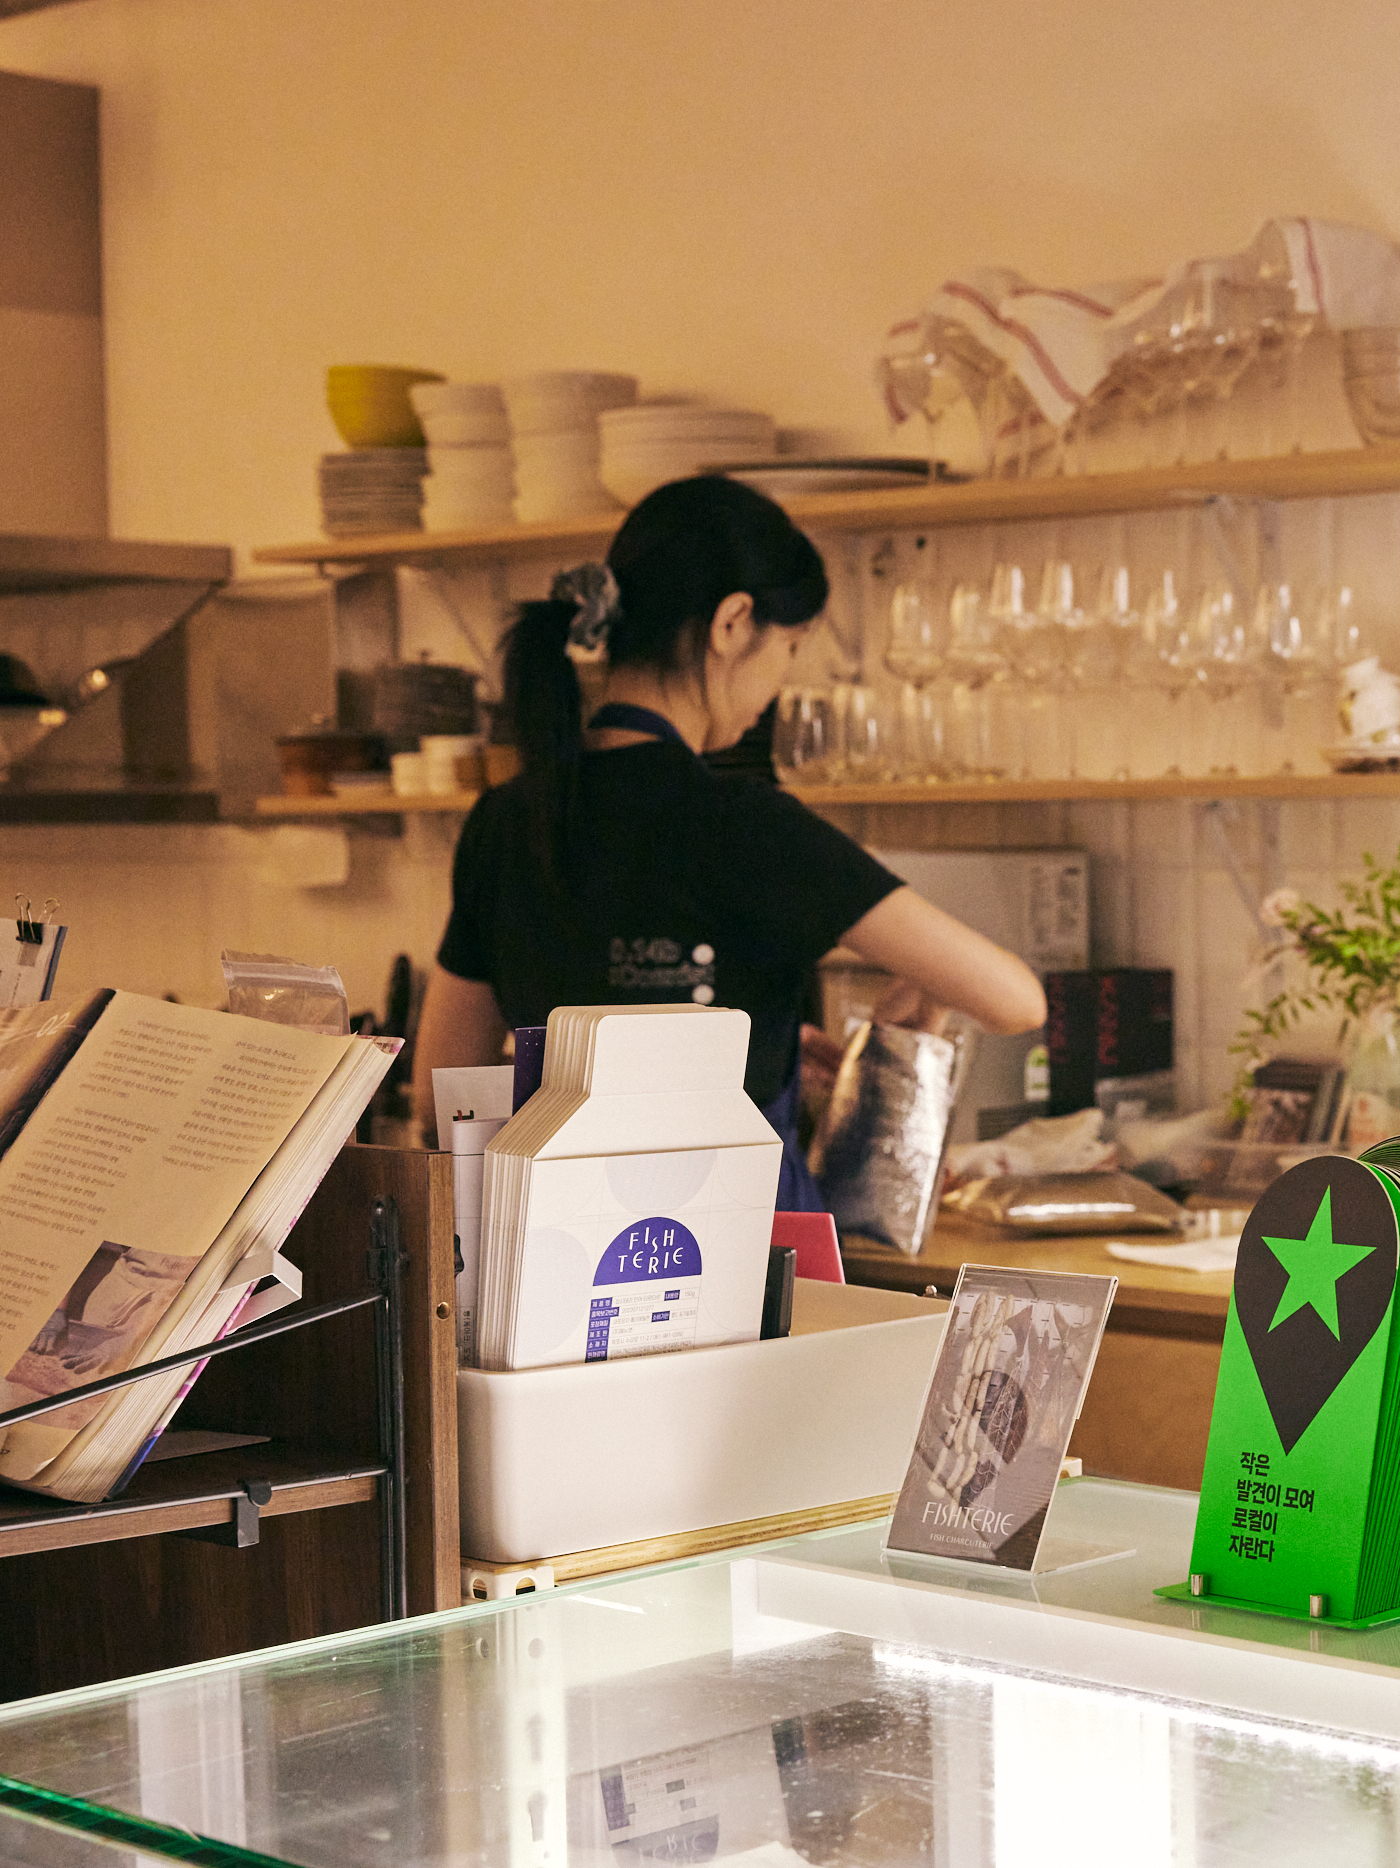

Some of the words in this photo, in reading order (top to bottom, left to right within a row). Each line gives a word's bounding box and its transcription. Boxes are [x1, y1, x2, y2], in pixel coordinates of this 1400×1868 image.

[629, 1227, 674, 1254] FISH
[618, 1246, 684, 1275] TERIE
[1240, 1451, 1271, 1477] 작은
[1236, 1479, 1282, 1507] 발견이
[1282, 1487, 1316, 1513] 모여
[921, 1501, 1015, 1536] FISHTERIE
[1231, 1507, 1279, 1535] 로컬이
[1228, 1534, 1276, 1563] 자란다
